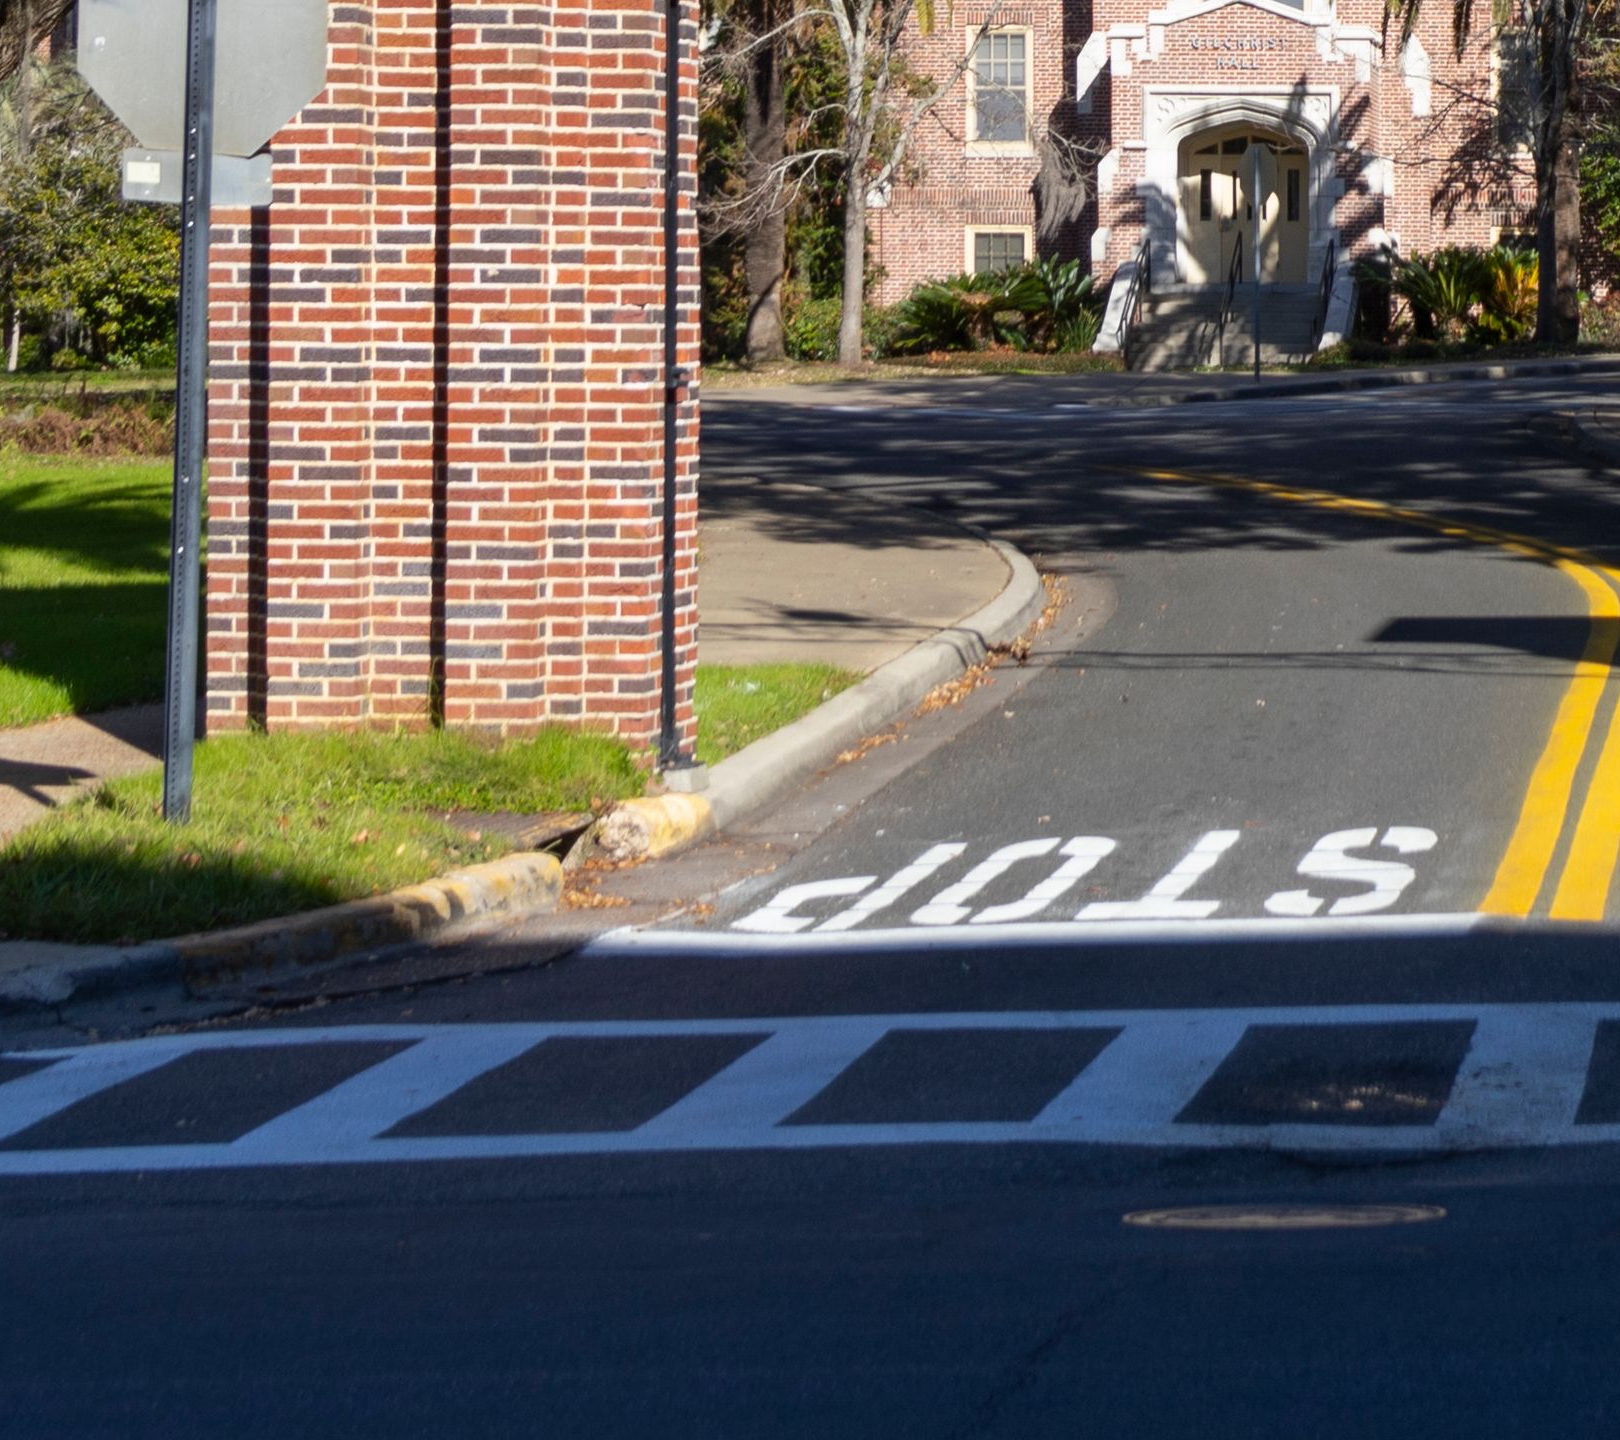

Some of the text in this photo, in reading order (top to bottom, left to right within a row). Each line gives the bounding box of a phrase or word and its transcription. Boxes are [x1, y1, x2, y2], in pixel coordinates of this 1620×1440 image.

[1190, 38, 1288, 51] GILCHRIST
[1215, 57, 1259, 70] HALL
[730, 827, 1438, 932] STOP
